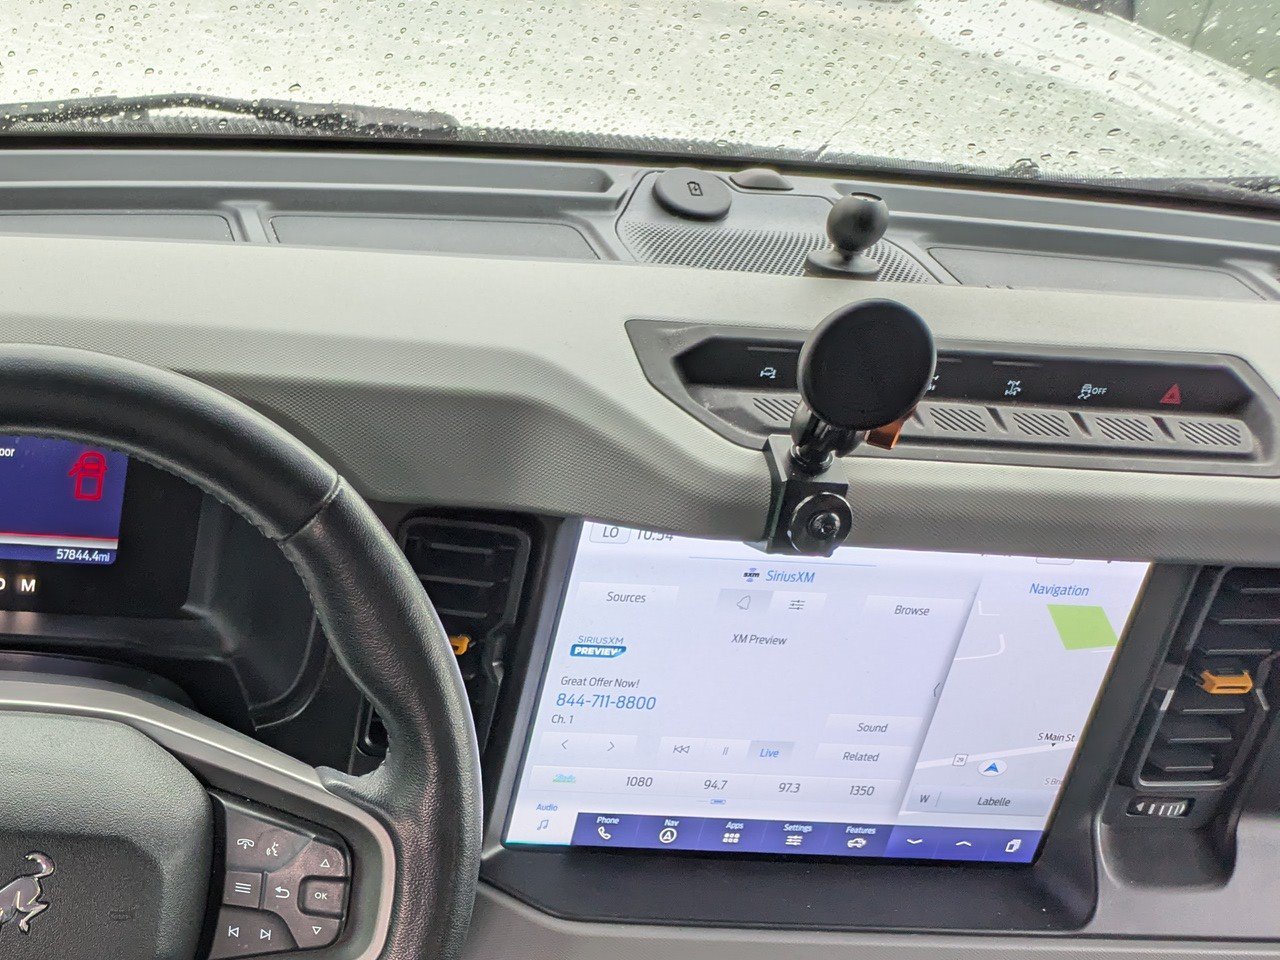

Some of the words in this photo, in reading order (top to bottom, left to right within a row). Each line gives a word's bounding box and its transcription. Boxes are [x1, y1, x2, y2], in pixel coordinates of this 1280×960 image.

[1091, 387, 1108, 395] OFF
[602, 526, 620, 538] LO
[766, 570, 816, 583] SiriusXM
[21, 579, 37, 593] M
[1029, 582, 1090, 597] Navigation
[606, 591, 646, 605] Sources
[894, 604, 931, 617] Browse
[577, 635, 624, 645] SIRIUSXM
[731, 634, 746, 645] XM
[748, 634, 787, 647] Preview
[574, 646, 622, 656] PREVIEW
[560, 676, 587, 687] Great
[588, 677, 613, 687] Offer
[614, 678, 640, 689] Now!
[556, 692, 657, 711] 844-711-8800
[551, 714, 566, 724] Ch.
[569, 715, 574, 724] 1
[857, 722, 888, 733] Sound
[1037, 732, 1044, 741] S
[1043, 733, 1064, 742] Main
[1065, 733, 1075, 742] St
[759, 747, 779, 758] Live
[842, 751, 879, 763] Related
[626, 776, 653, 788] 1080
[703, 779, 728, 790] 94.7
[778, 782, 801, 794] 97.3
[849, 785, 874, 797] 1350
[919, 793, 930, 803] W
[977, 796, 1011, 807] Labelle
[536, 802, 558, 812] Audio
[596, 815, 619, 825] Phone
[664, 818, 679, 827] Nav
[726, 821, 744, 832] Apps
[783, 823, 813, 835] Settings
[846, 826, 876, 835] Features
[314, 892, 328, 900] OK
